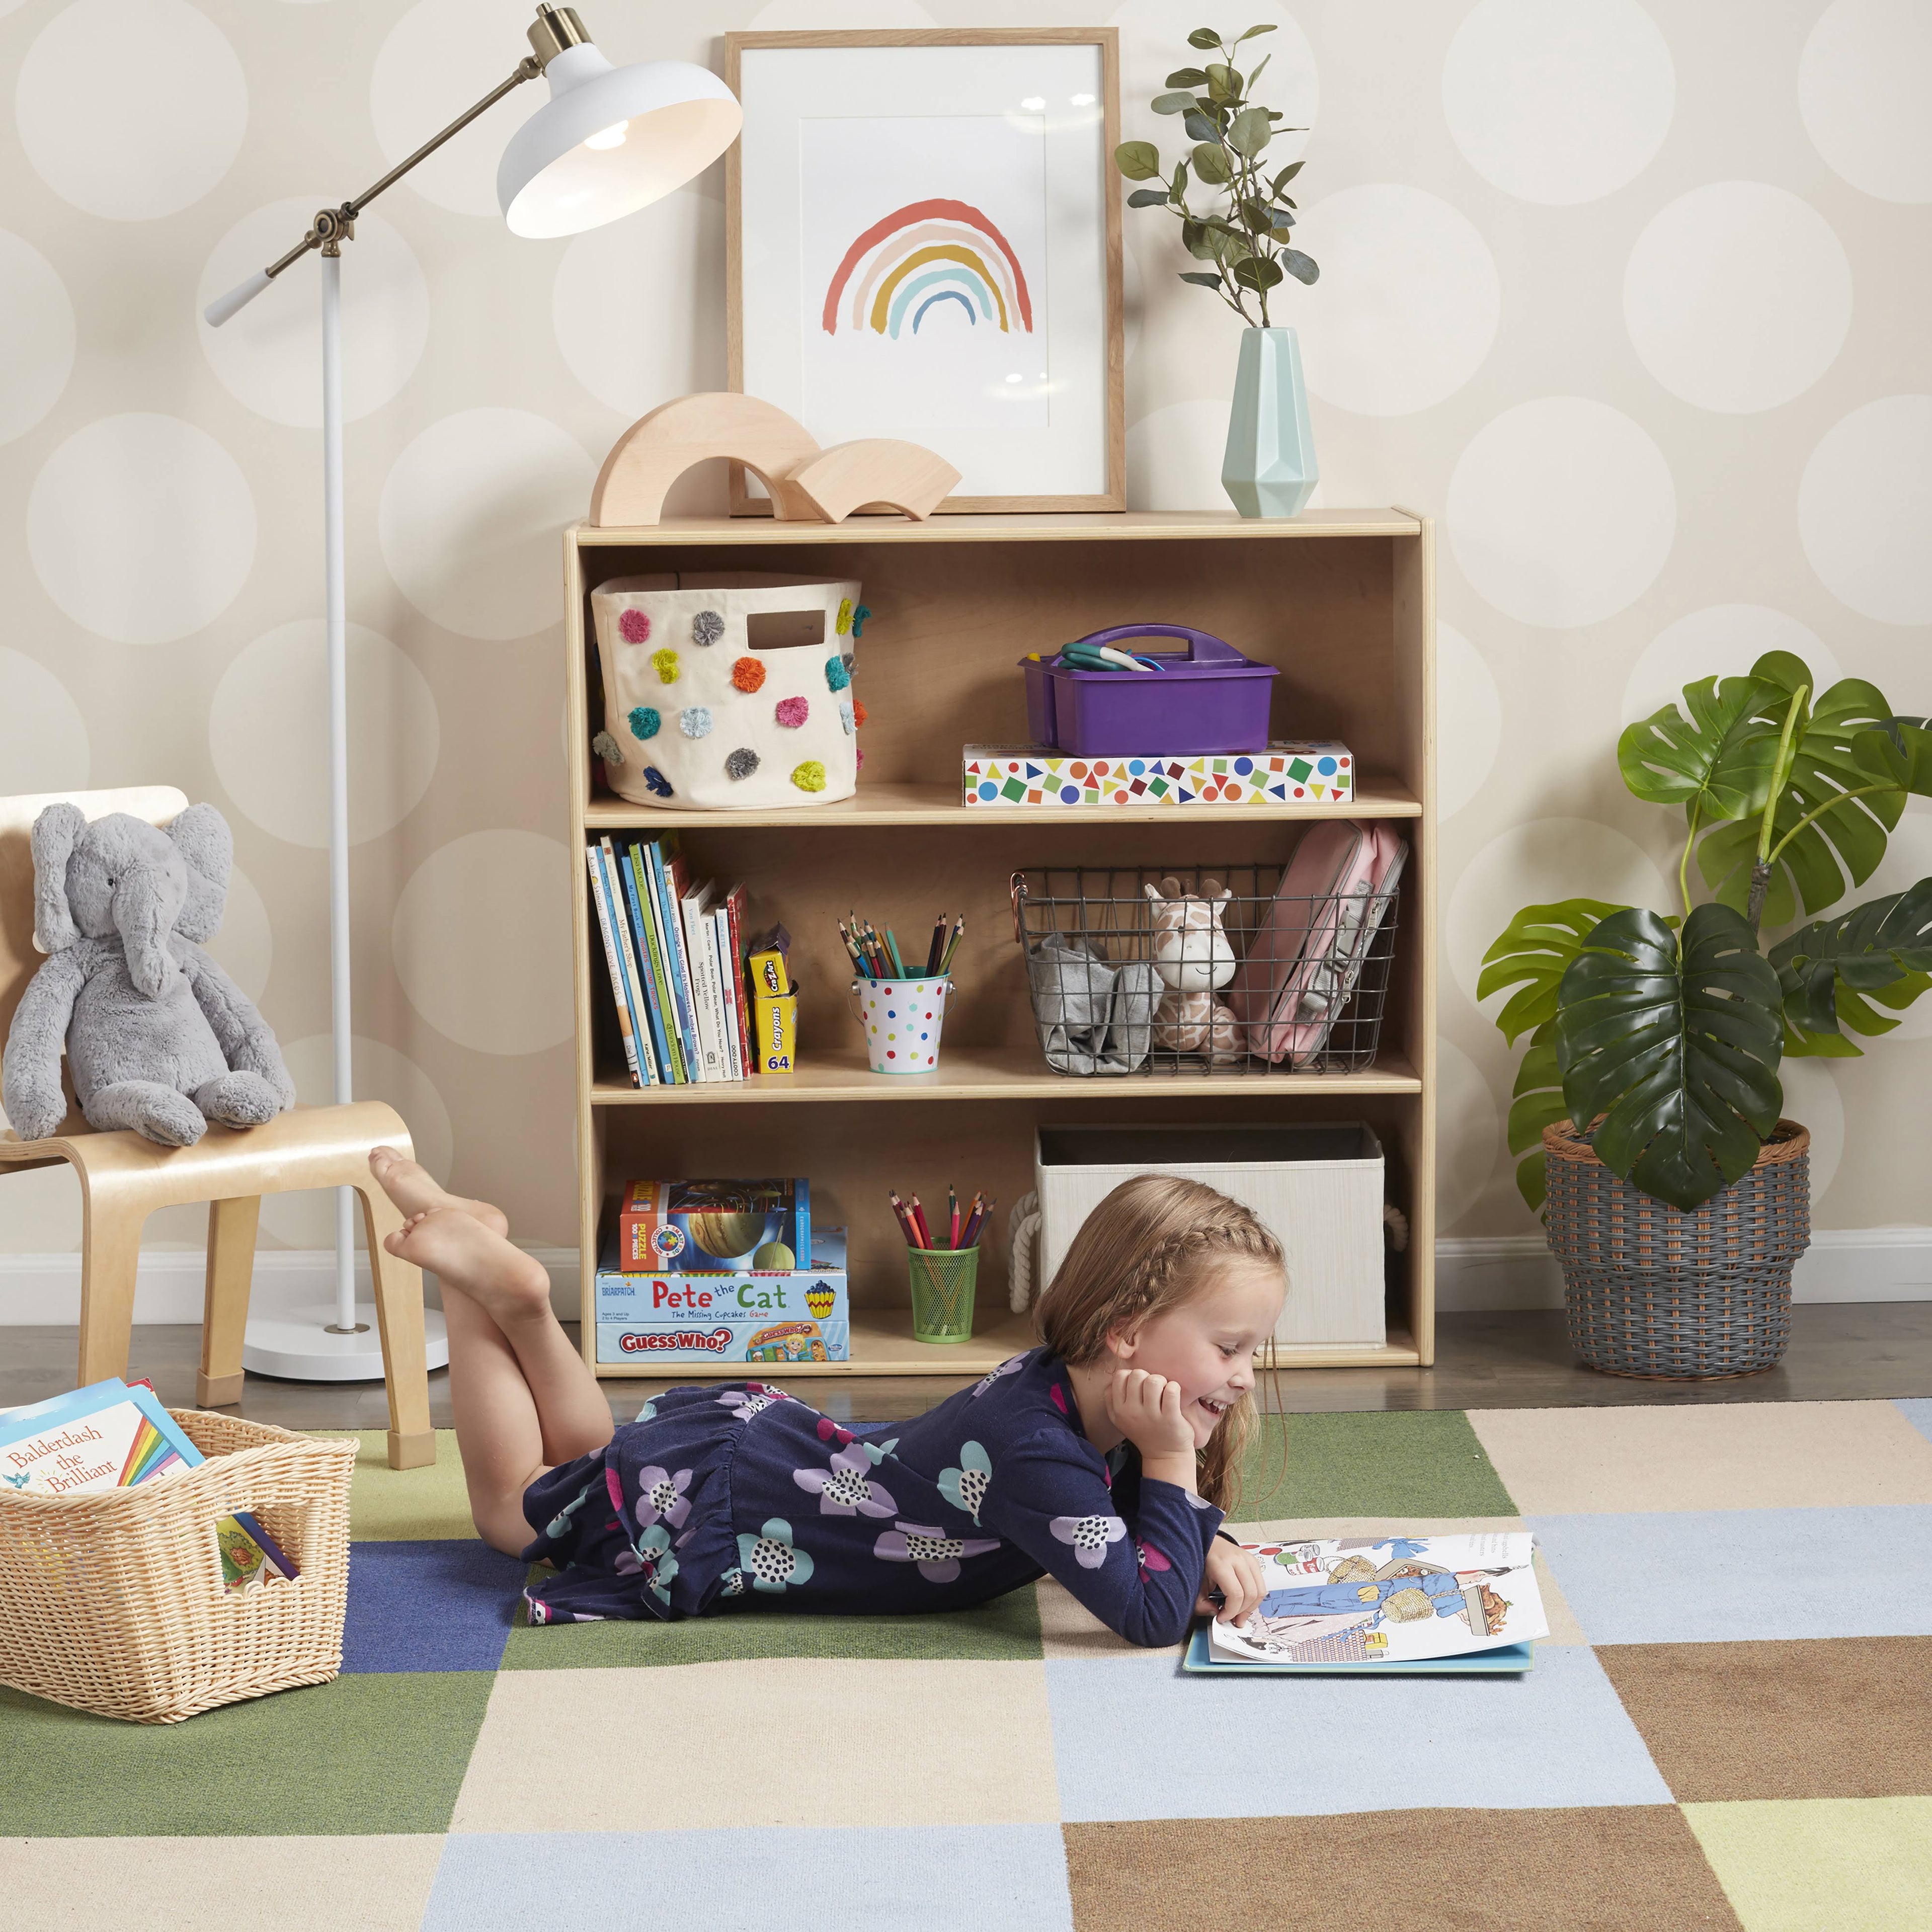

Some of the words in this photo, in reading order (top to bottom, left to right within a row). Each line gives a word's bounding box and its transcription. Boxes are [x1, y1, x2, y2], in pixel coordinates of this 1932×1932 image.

[594, 886, 602, 911] Salmieri
[619, 919, 625, 929] My
[621, 930, 630, 952] Father's
[650, 934, 659, 968] Ducklings
[601, 918, 611, 948] DRAGONS
[607, 951, 615, 969] LOVE
[611, 973, 621, 995] TACOS
[639, 937, 649, 963] DIGGERS
[650, 987, 659, 1010] TRUCKS
[698, 962, 707, 988] Spotted
[772, 1007, 784, 1051] Crayons
[668, 1029, 677, 1056] Random
[673, 1057, 681, 1077] House
[692, 1034, 700, 1055] Brown?
[768, 1056, 789, 1071] 64
[638, 1223, 647, 1260] PUZZLE
[652, 1228, 664, 1255] COLLECTION
[672, 1227, 684, 1244] SMART
[672, 1244, 684, 1255] KIDS
[652, 1280, 712, 1309] Pete
[714, 1284, 735, 1297] the
[737, 1284, 787, 1309] Cat
[688, 1310, 711, 1320] Missing
[714, 1311, 746, 1320] Cupcakes
[621, 1334, 677, 1352] Guess
[676, 1329, 732, 1353] Who?
[763, 1329, 783, 1340] Guess
[783, 1324, 803, 1334] Who?
[6, 1425, 104, 1469] Balderdash
[56, 1454, 84, 1471] the
[45, 1460, 118, 1493] Brilliant
